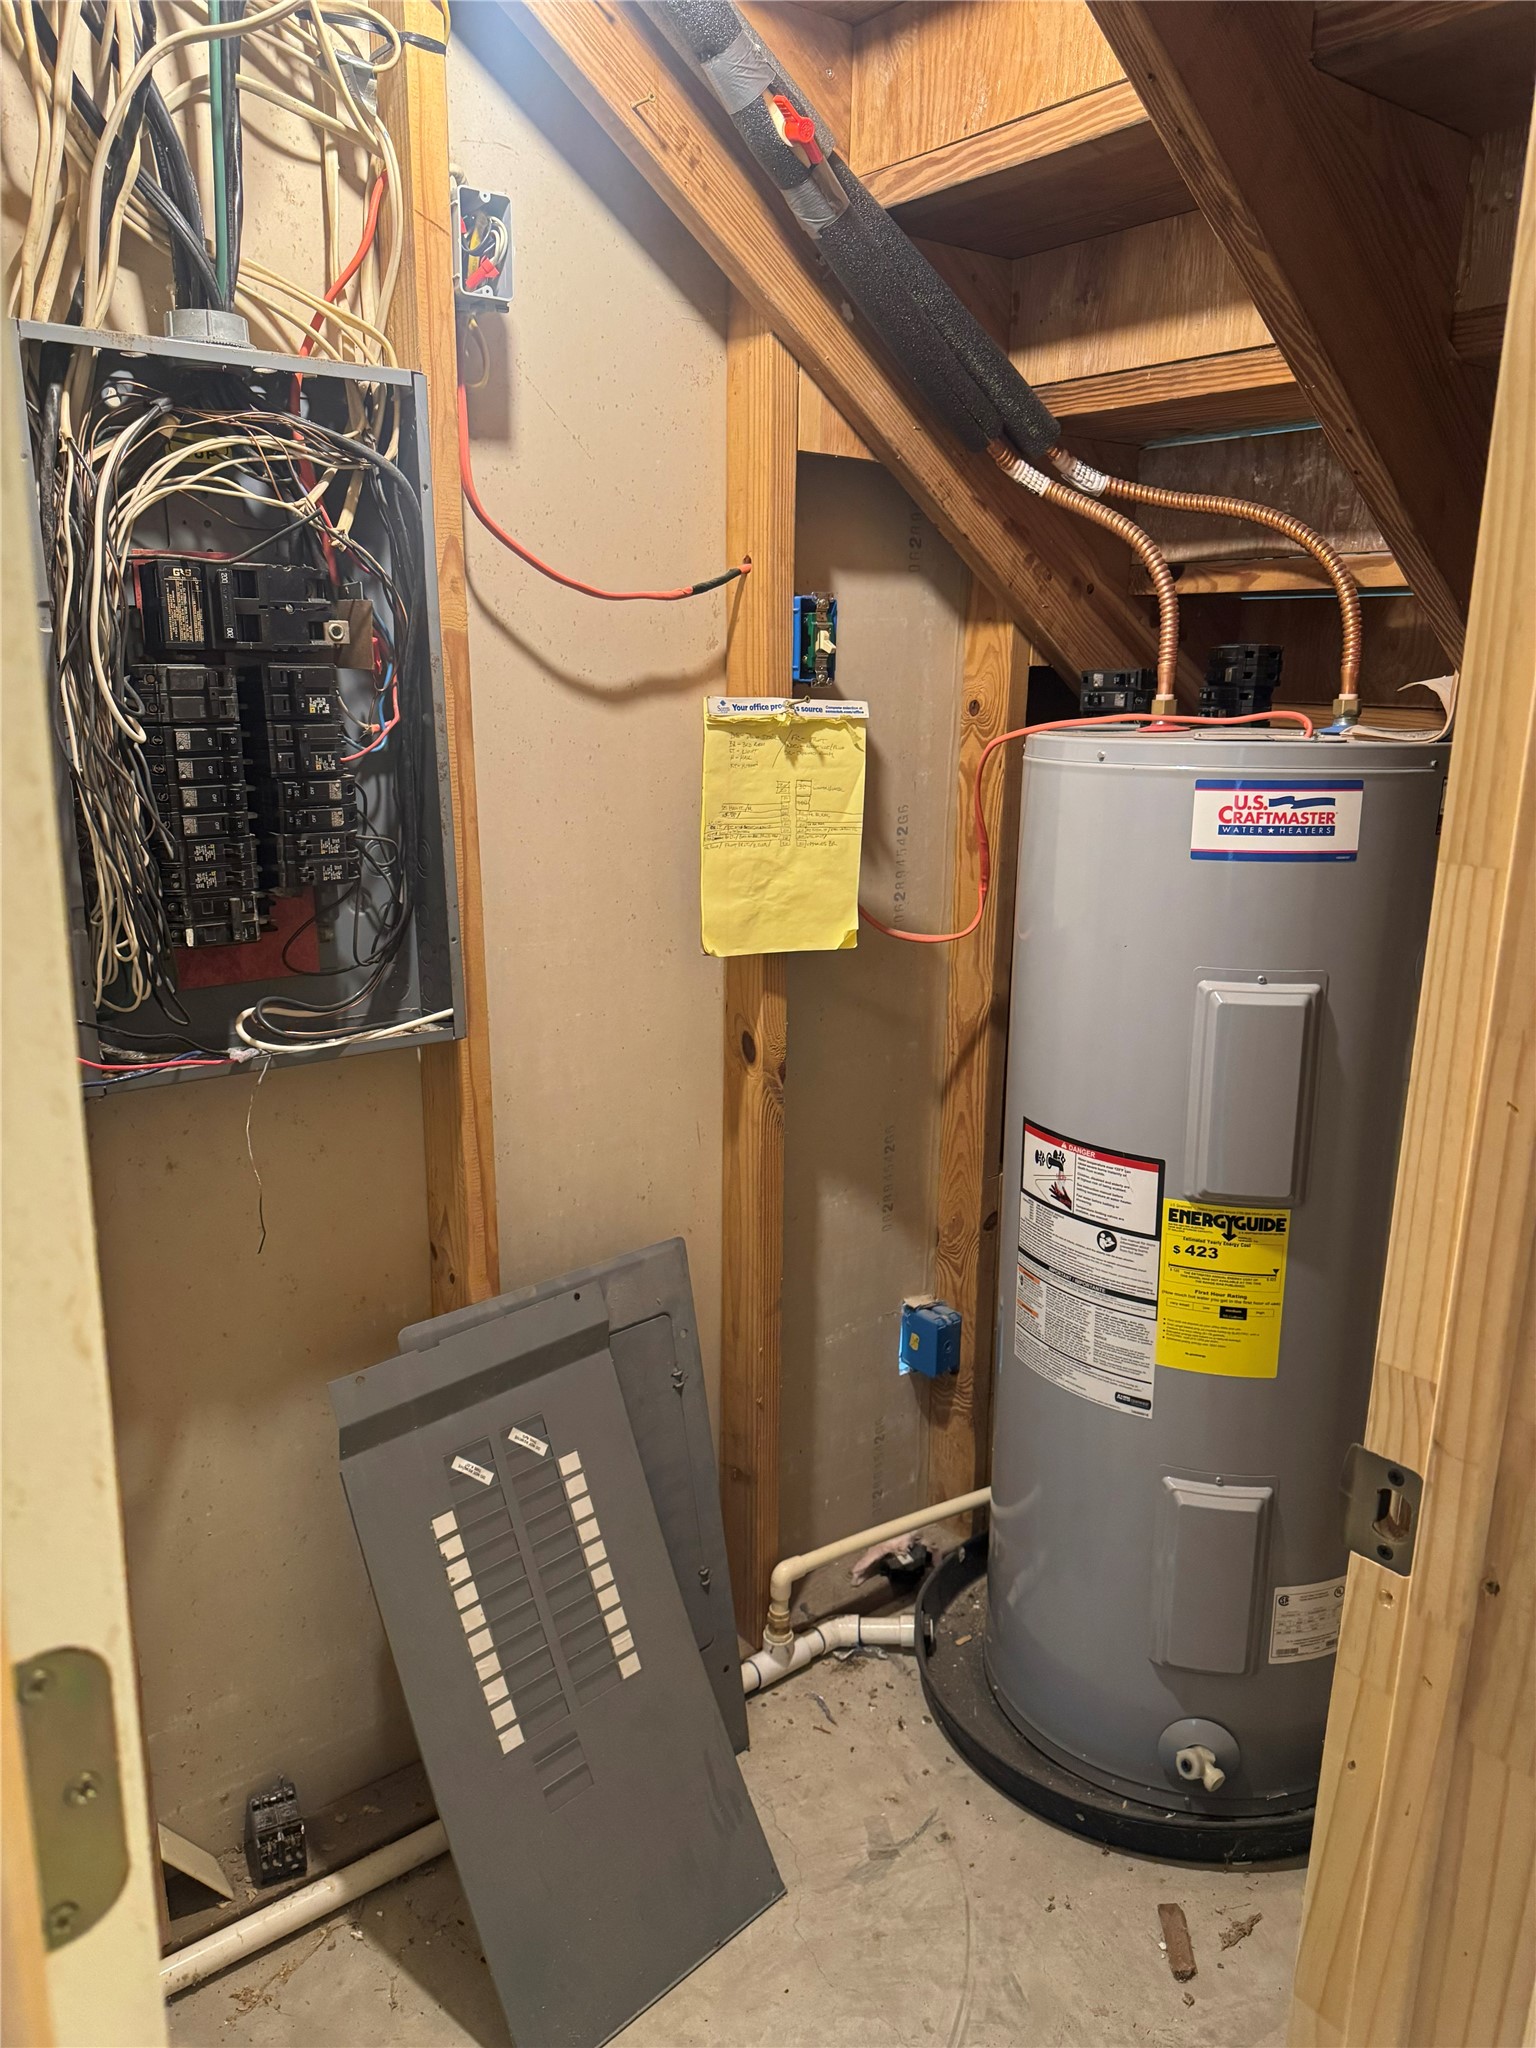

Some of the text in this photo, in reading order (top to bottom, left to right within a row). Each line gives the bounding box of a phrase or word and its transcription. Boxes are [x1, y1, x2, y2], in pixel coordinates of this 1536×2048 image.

[732, 703, 748, 711] Your
[770, 704, 799, 712] pros
[799, 705, 823, 713] source
[1234, 795, 1268, 810] U.S.
[1218, 806, 1336, 825] CRAFTMASTER
[1222, 826, 1263, 834] WATER
[1068, 1144, 1096, 1159] DANGER
[1168, 1208, 1287, 1233] ENERGYGUIDE
[1183, 1236, 1206, 1244] Estimated
[1207, 1239, 1222, 1247] Yearly
[1173, 1245, 1219, 1259] $ 423
